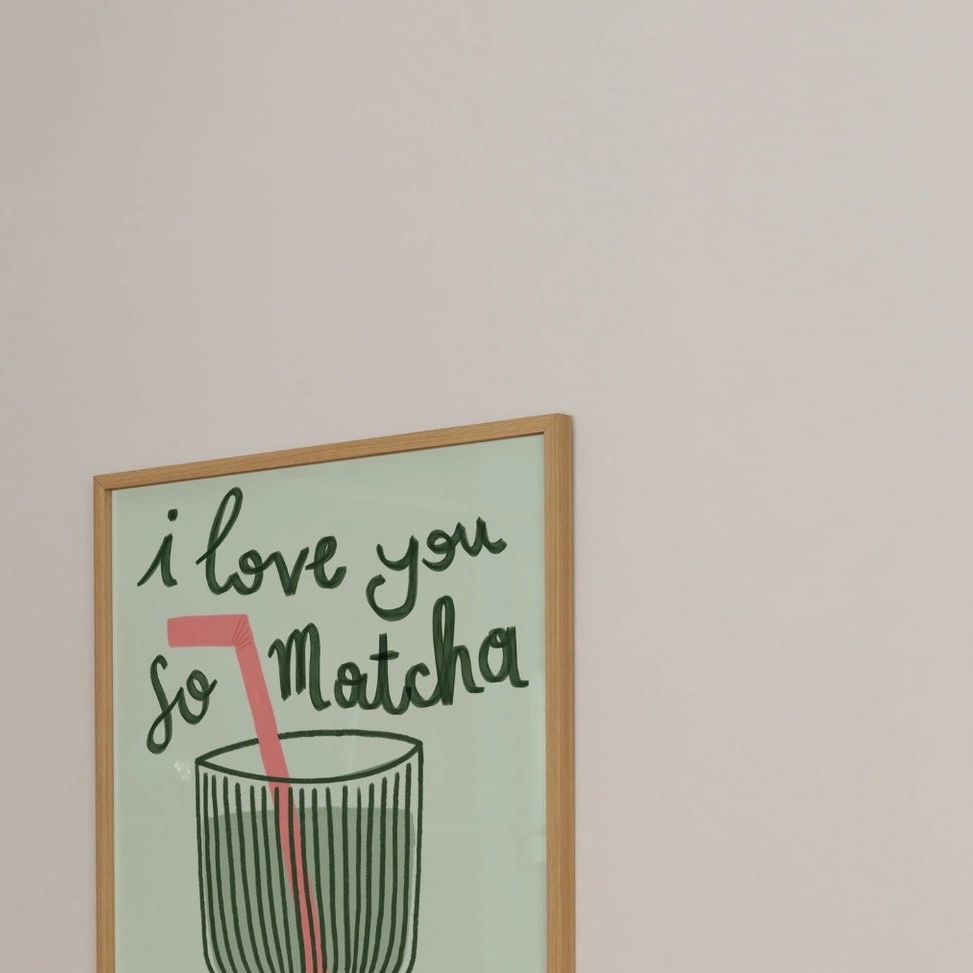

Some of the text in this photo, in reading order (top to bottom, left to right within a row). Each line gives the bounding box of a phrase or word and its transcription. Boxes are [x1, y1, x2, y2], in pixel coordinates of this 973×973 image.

[136, 486, 508, 622] i love you
